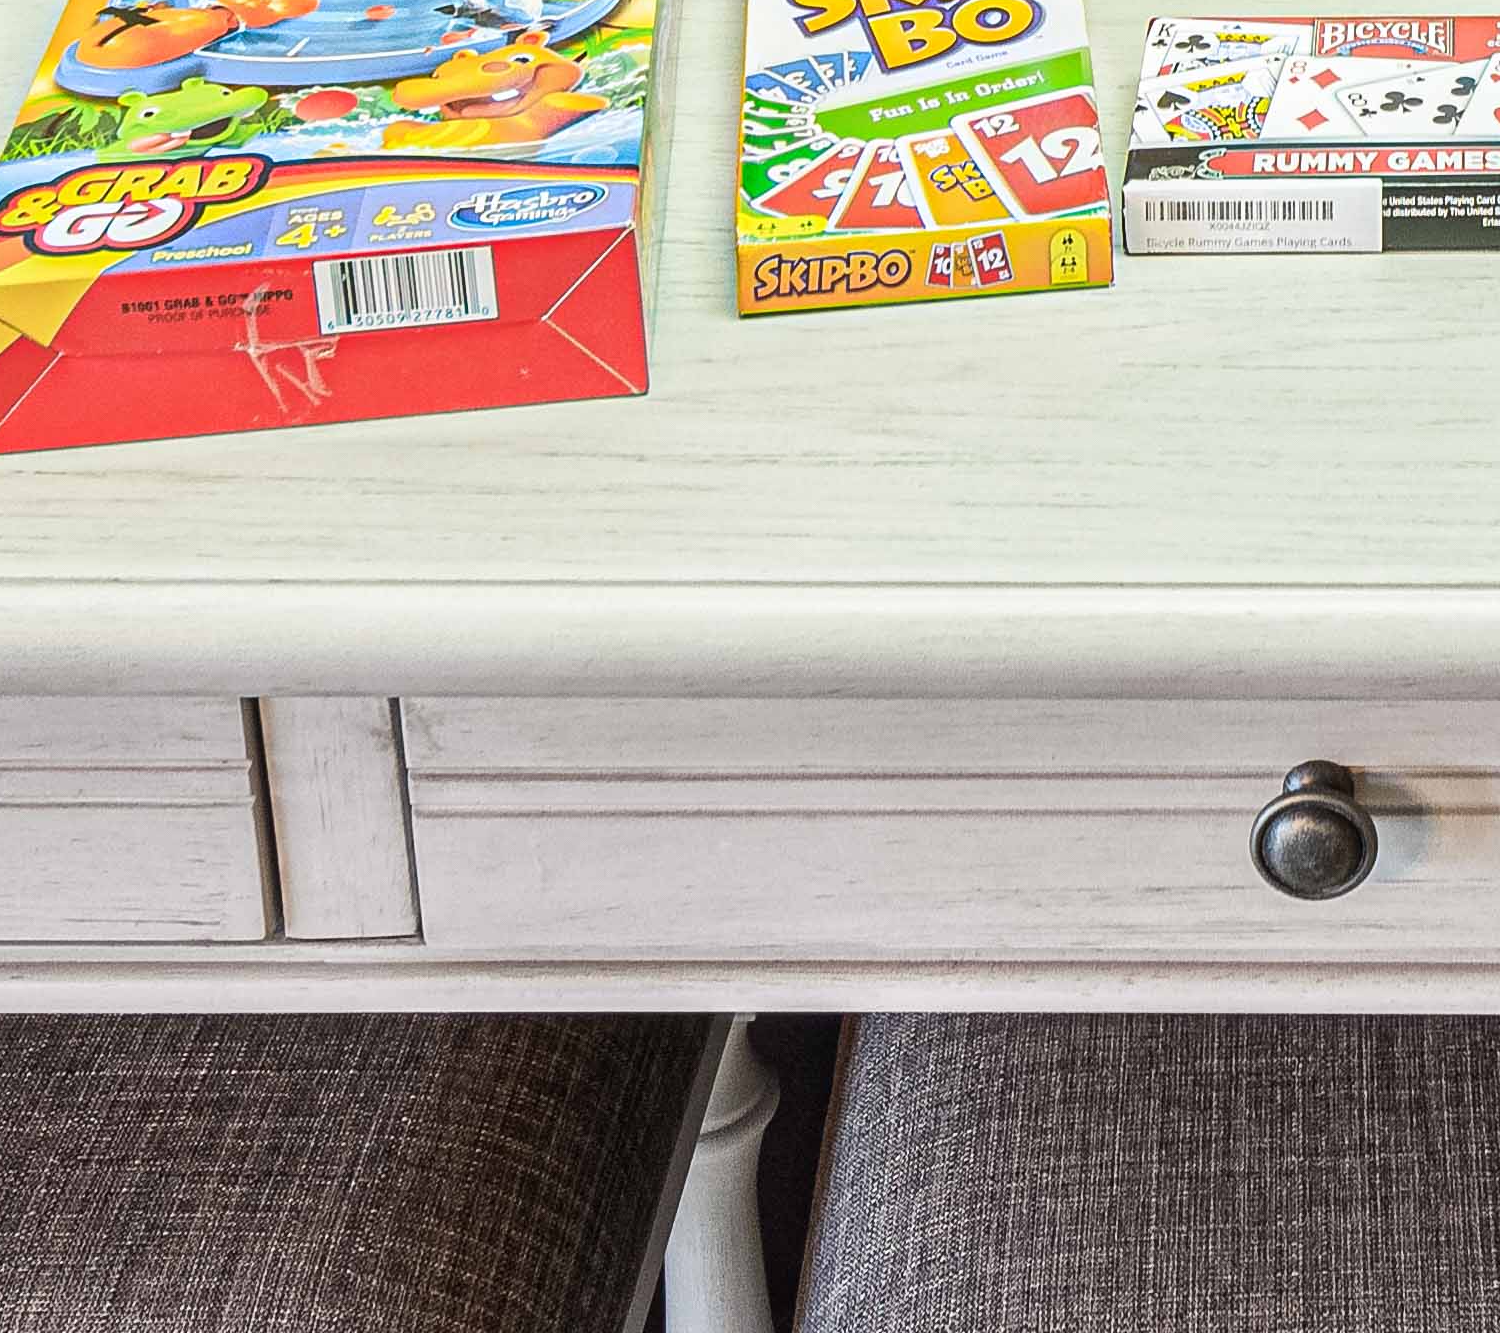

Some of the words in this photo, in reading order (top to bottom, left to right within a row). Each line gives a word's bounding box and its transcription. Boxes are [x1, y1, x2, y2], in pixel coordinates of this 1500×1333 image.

[1320, 20, 1447, 54] BICYCLE
[869, 105, 913, 122] Fun
[919, 97, 941, 110] Is
[946, 89, 971, 106] In
[975, 71, 1045, 96] Order!
[973, 114, 1020, 139] 12
[1001, 127, 1101, 184] 12
[1253, 151, 1379, 173] RUMMY
[56, 162, 252, 206] GRAB
[472, 188, 595, 212] Hasbro
[152, 244, 252, 265] Preschool
